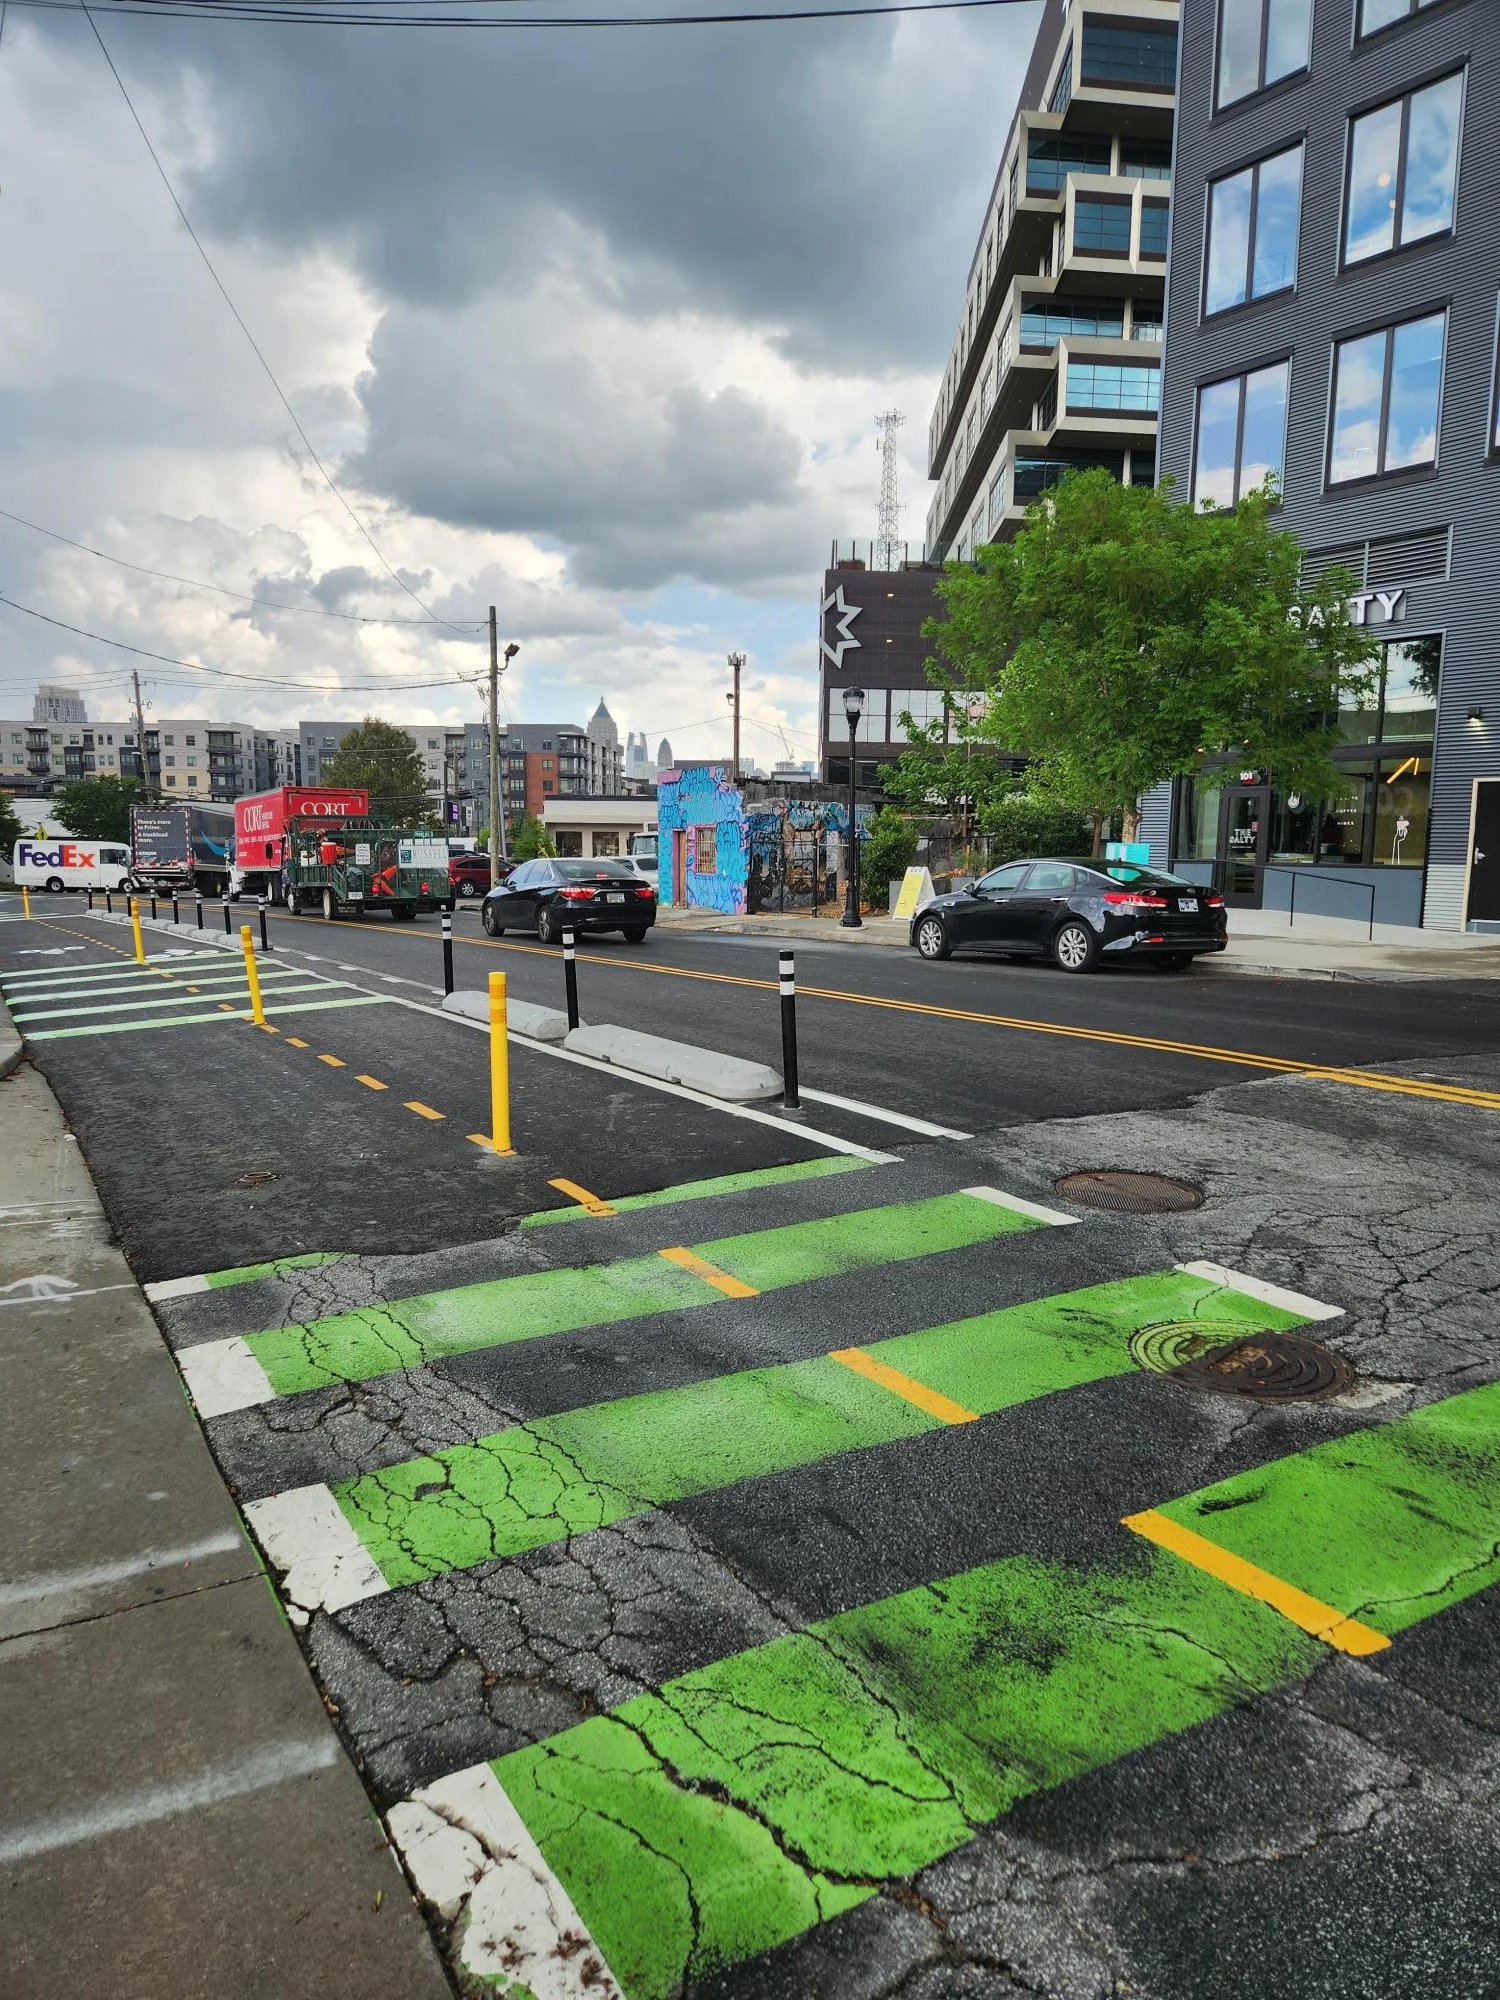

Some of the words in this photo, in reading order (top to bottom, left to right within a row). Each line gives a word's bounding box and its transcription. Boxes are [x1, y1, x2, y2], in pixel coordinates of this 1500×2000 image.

[1240, 772, 1253, 781] 101
[301, 801, 349, 816] CORT
[243, 804, 263, 833] CORT
[1234, 828, 1252, 837] THE
[1229, 836, 1256, 844] SALTY
[19, 843, 95, 868] FedEx
